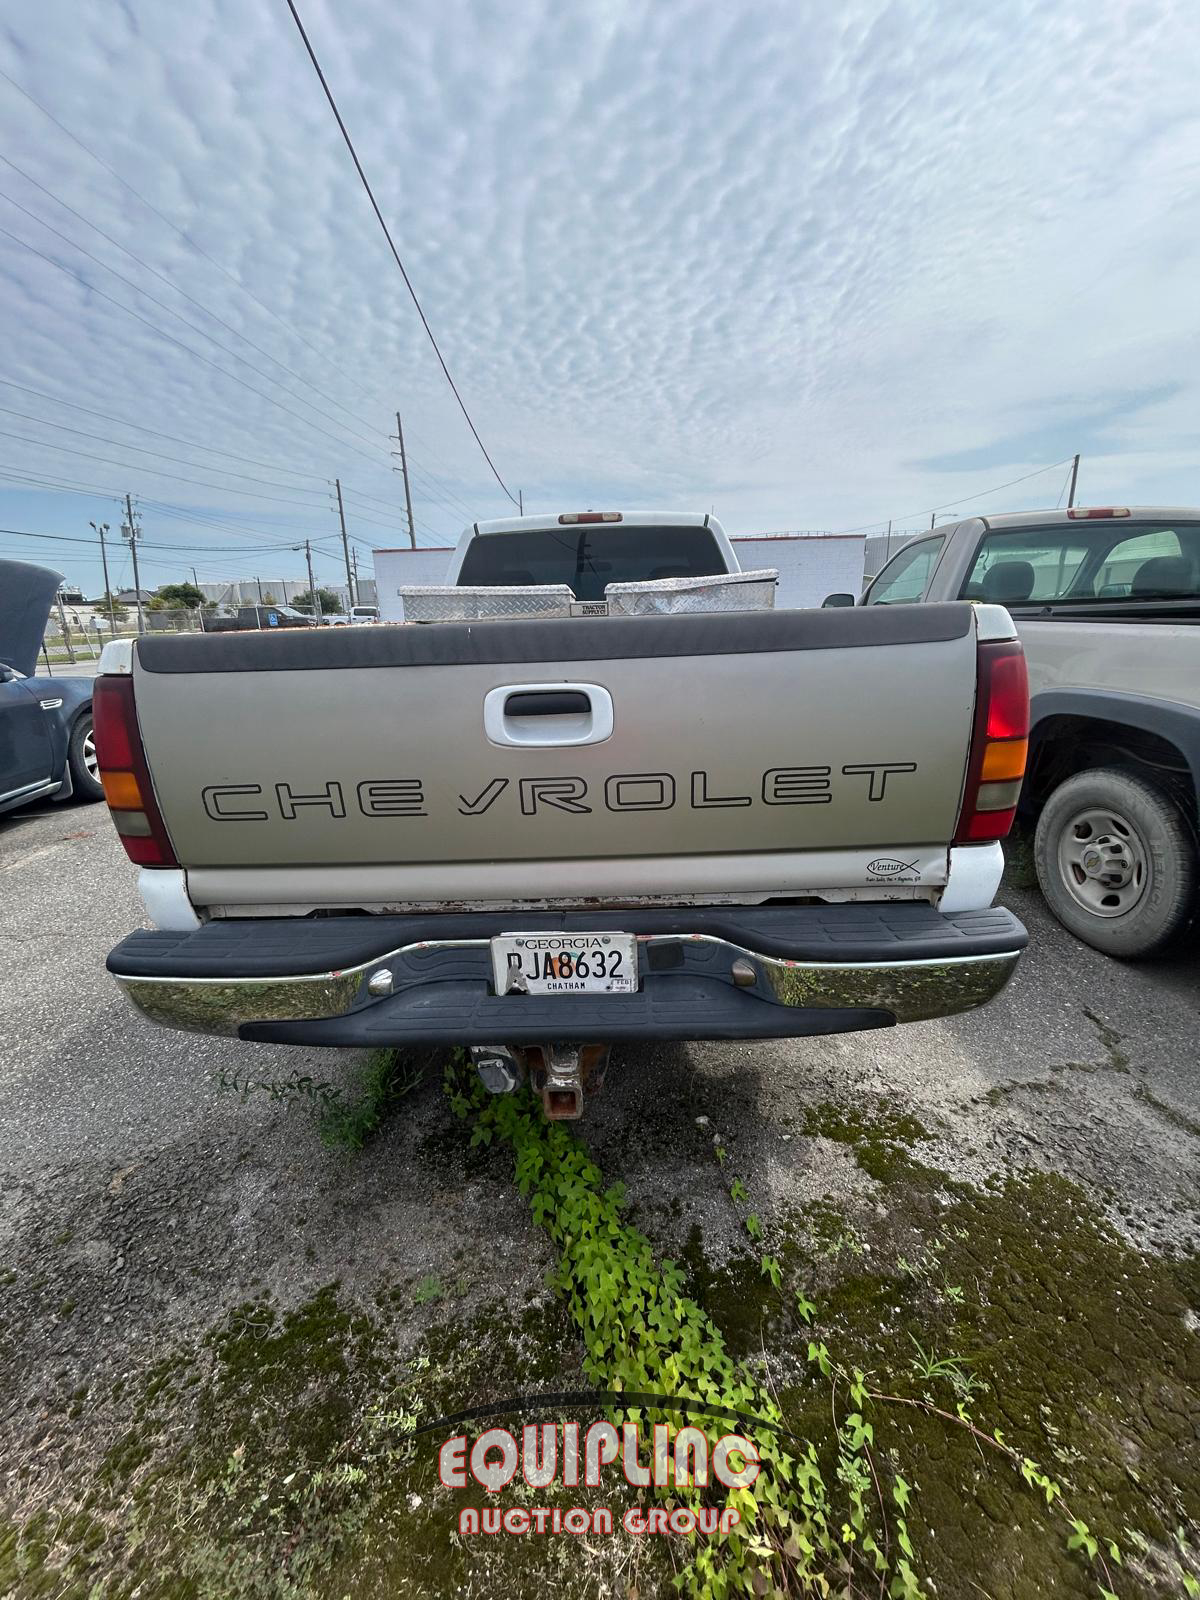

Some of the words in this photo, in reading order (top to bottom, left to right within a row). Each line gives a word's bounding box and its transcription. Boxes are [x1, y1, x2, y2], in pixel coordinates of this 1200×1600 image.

[202, 762, 917, 821] CHEVROLET
[870, 861, 904, 871] Venture
[525, 937, 602, 950] GEORGIA
[547, 982, 586, 990] CHATHAM
